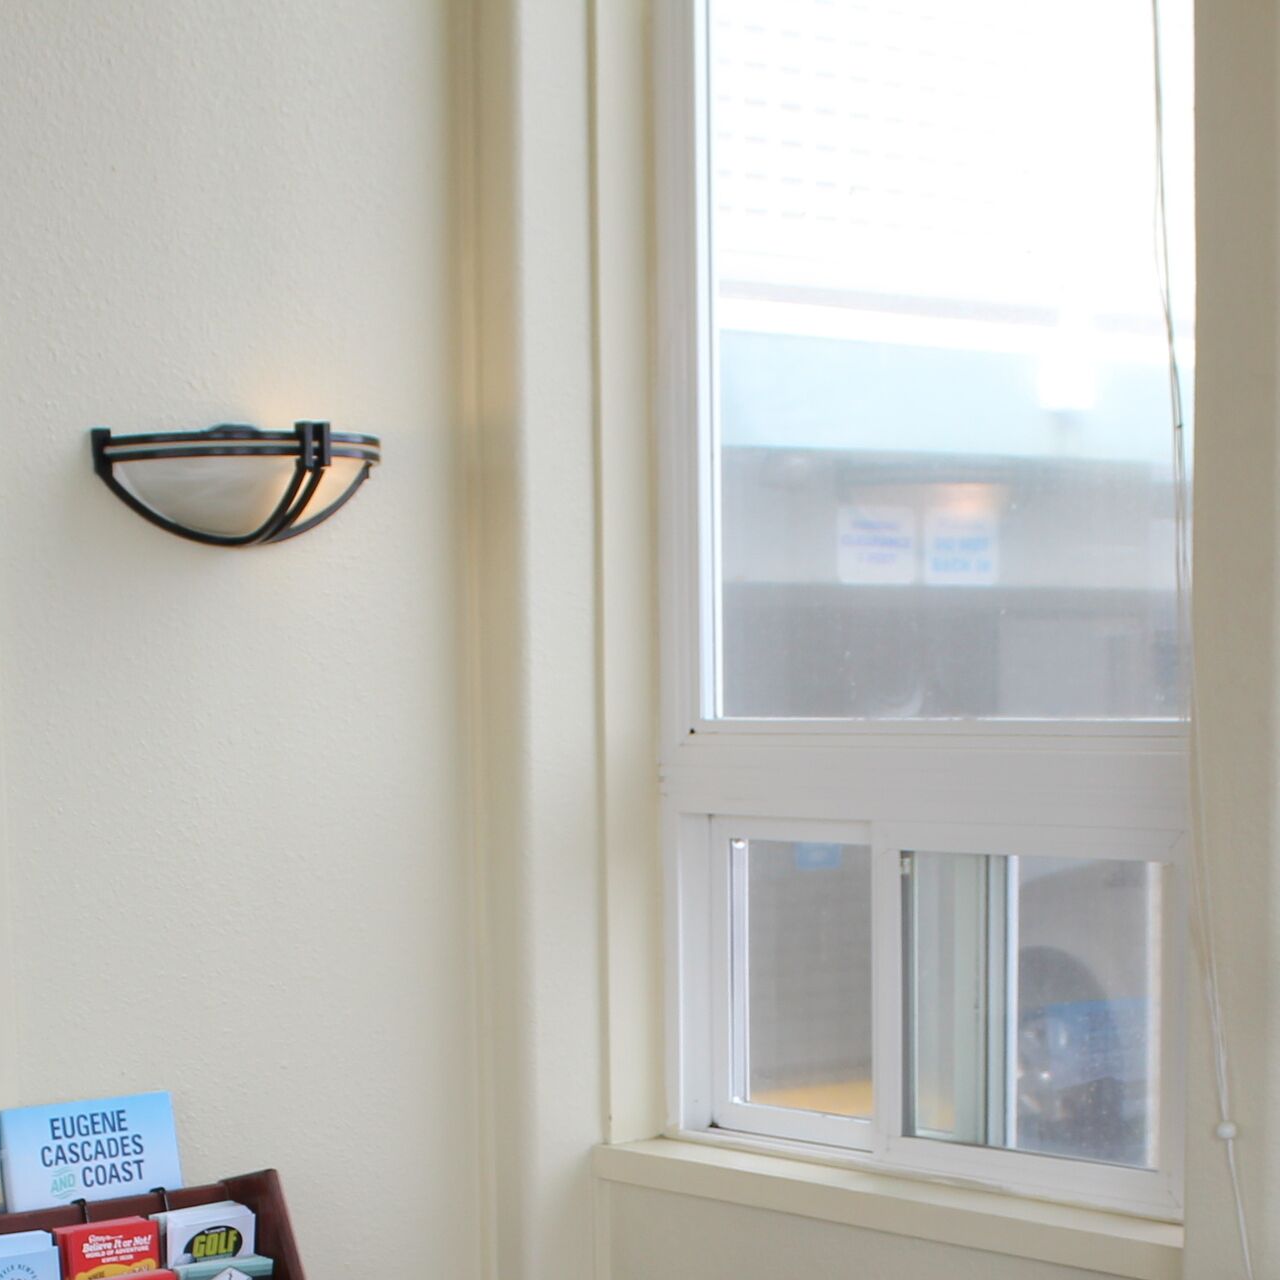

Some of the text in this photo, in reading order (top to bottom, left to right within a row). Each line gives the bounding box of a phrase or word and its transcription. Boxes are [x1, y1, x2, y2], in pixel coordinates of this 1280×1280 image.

[50, 1109, 128, 1141] EUGENE
[41, 1134, 144, 1168] CASCADES
[51, 1160, 145, 1192] AND COAST
[192, 1229, 239, 1259] GOLF
